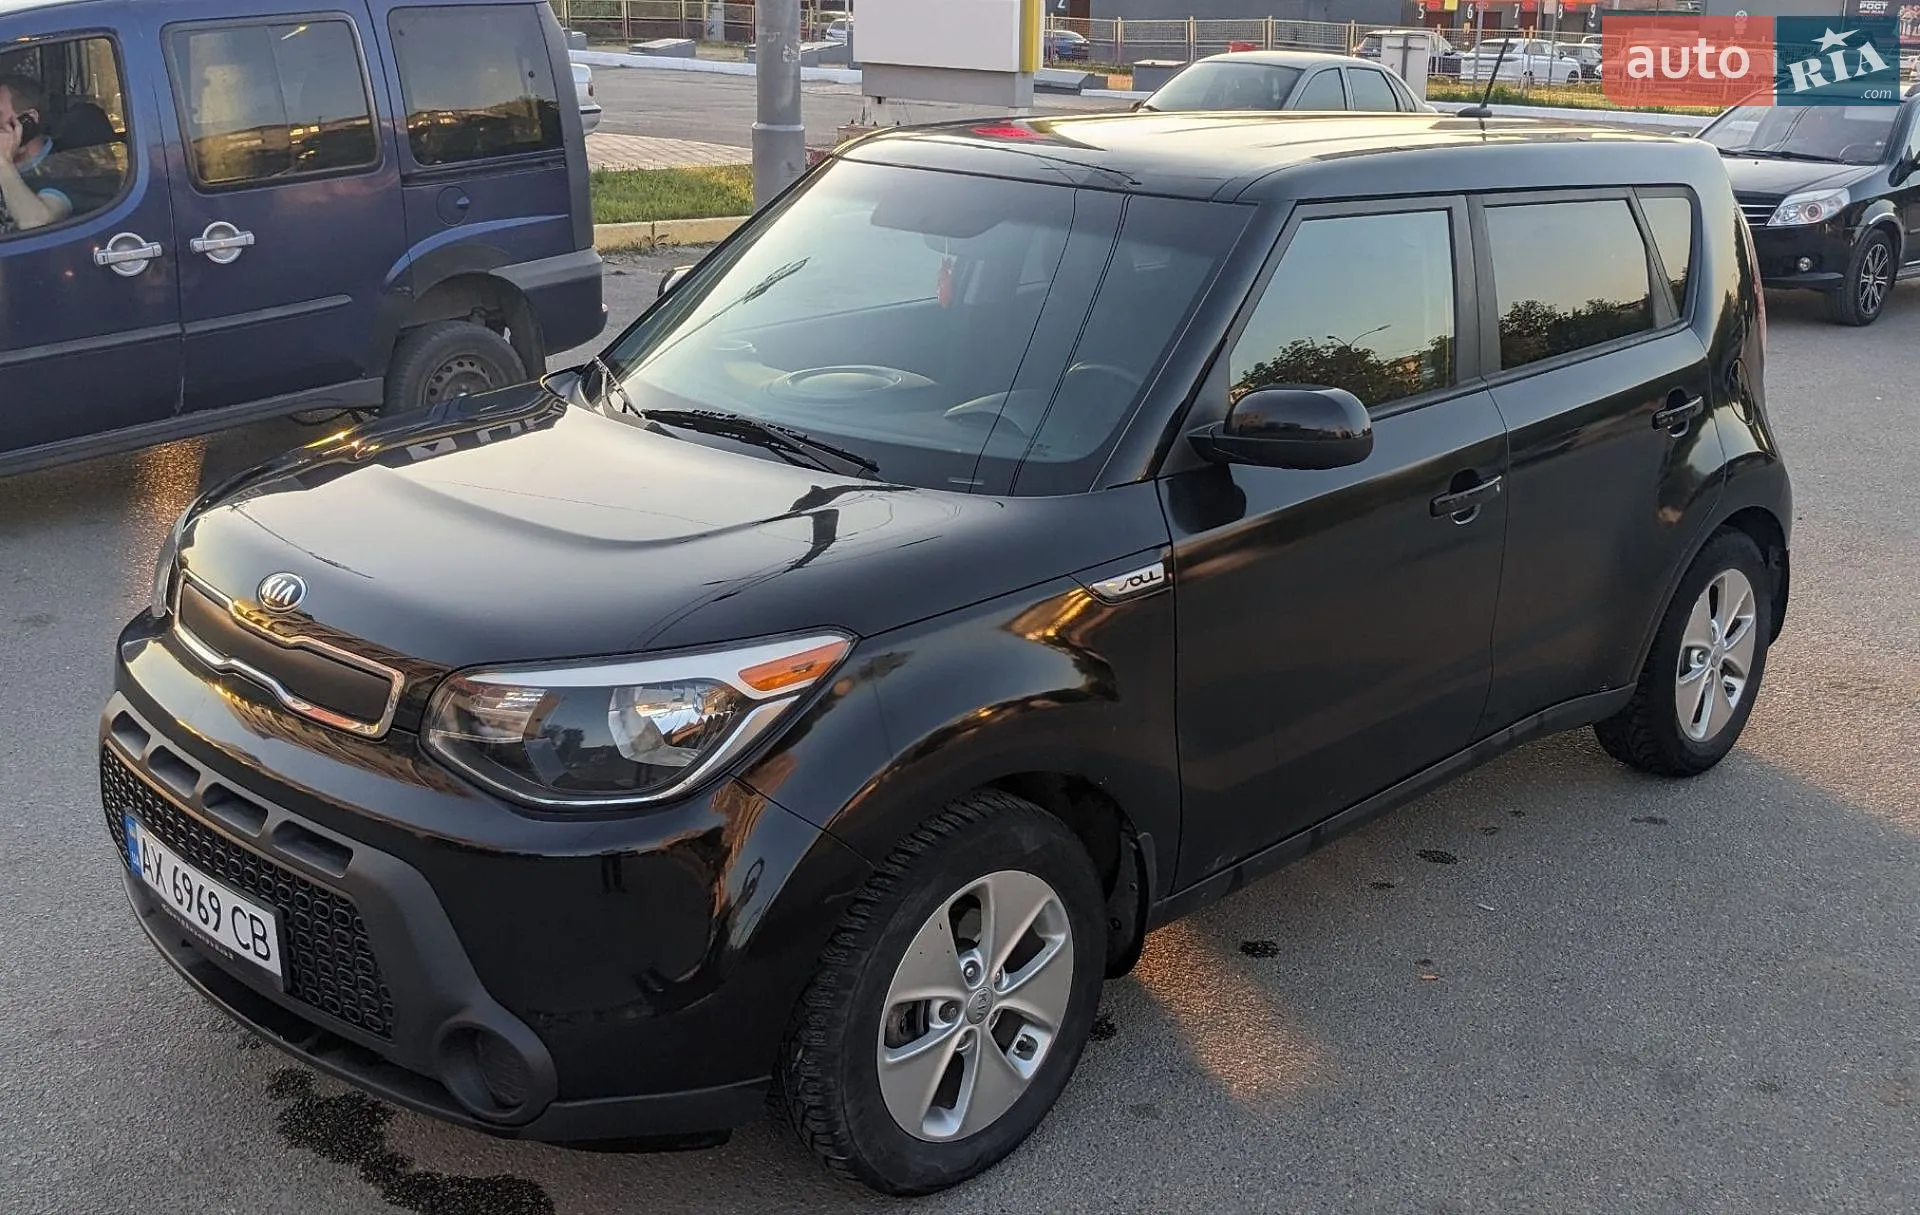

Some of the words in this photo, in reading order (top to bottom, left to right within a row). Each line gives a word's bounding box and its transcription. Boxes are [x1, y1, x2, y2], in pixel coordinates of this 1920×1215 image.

[1418, 3, 1425, 20] 5
[1466, 3, 1473, 20] 6
[1513, 3, 1520, 19] 7
[1557, 3, 1563, 19] 8
[141, 837, 168, 894] AX
[172, 865, 222, 933] 6969
[231, 905, 271, 962] CB
